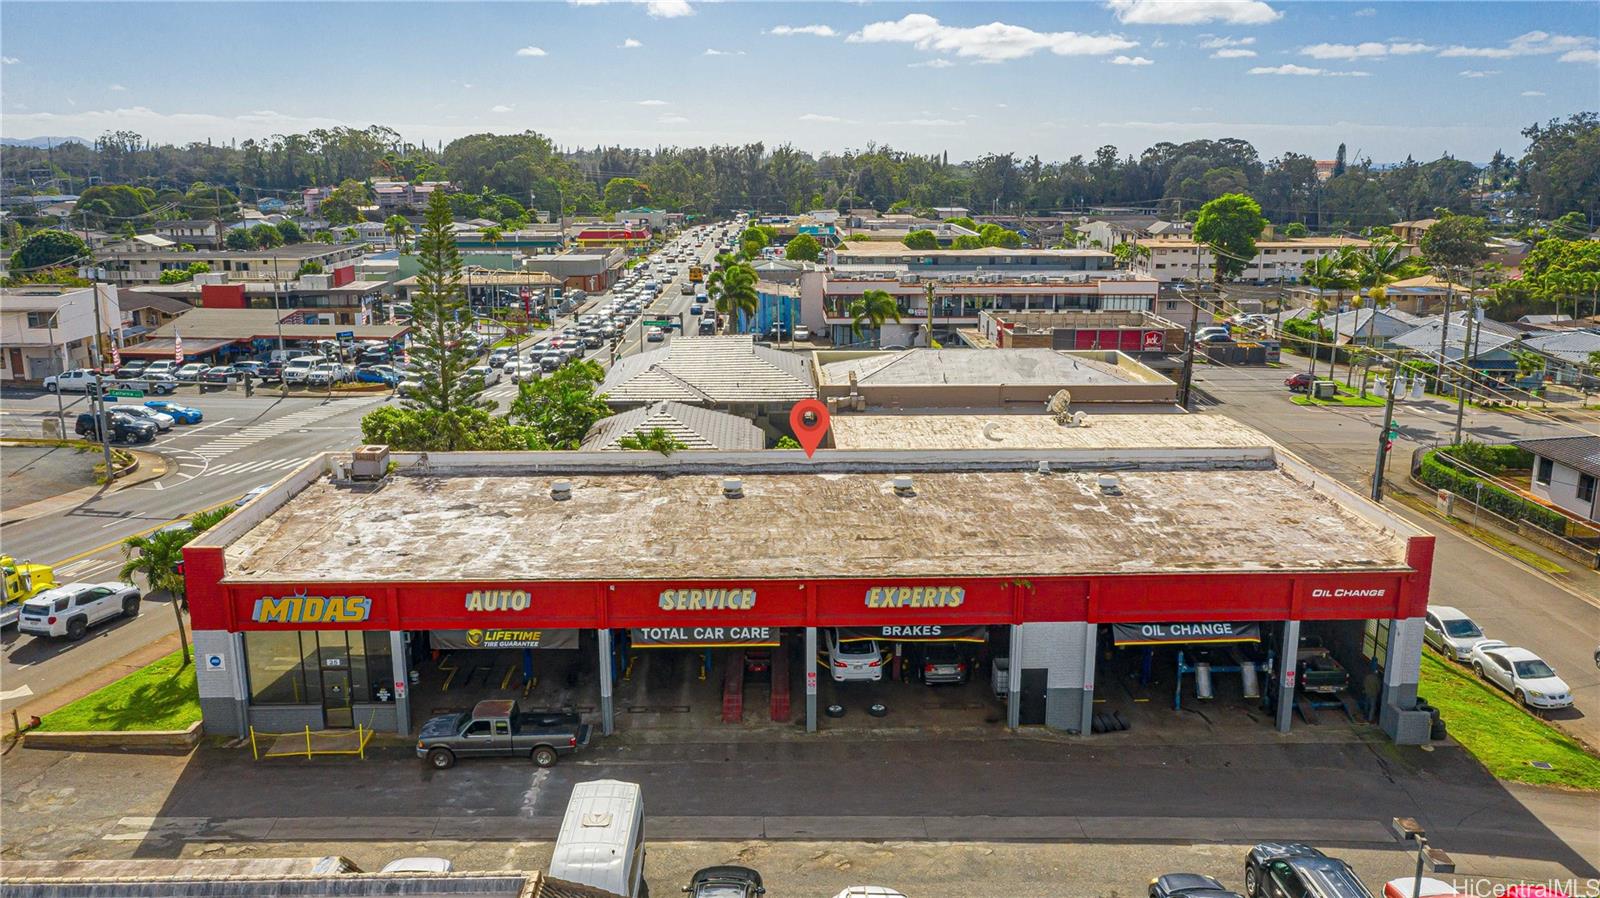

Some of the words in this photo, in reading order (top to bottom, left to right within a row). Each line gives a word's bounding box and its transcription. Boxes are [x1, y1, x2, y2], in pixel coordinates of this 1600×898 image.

[467, 589, 526, 612] AUTO
[661, 588, 754, 611] SERVICE
[867, 586, 961, 608] EXPERTS
[258, 596, 365, 623] MIDAS
[484, 631, 542, 641] LIFETIME
[641, 628, 688, 640] TOTAL
[694, 627, 724, 640] CAR
[730, 627, 770, 639] CARE
[882, 625, 942, 636] BRAKES
[1142, 624, 1166, 637] OIL
[1170, 623, 1233, 636] CHANGE
